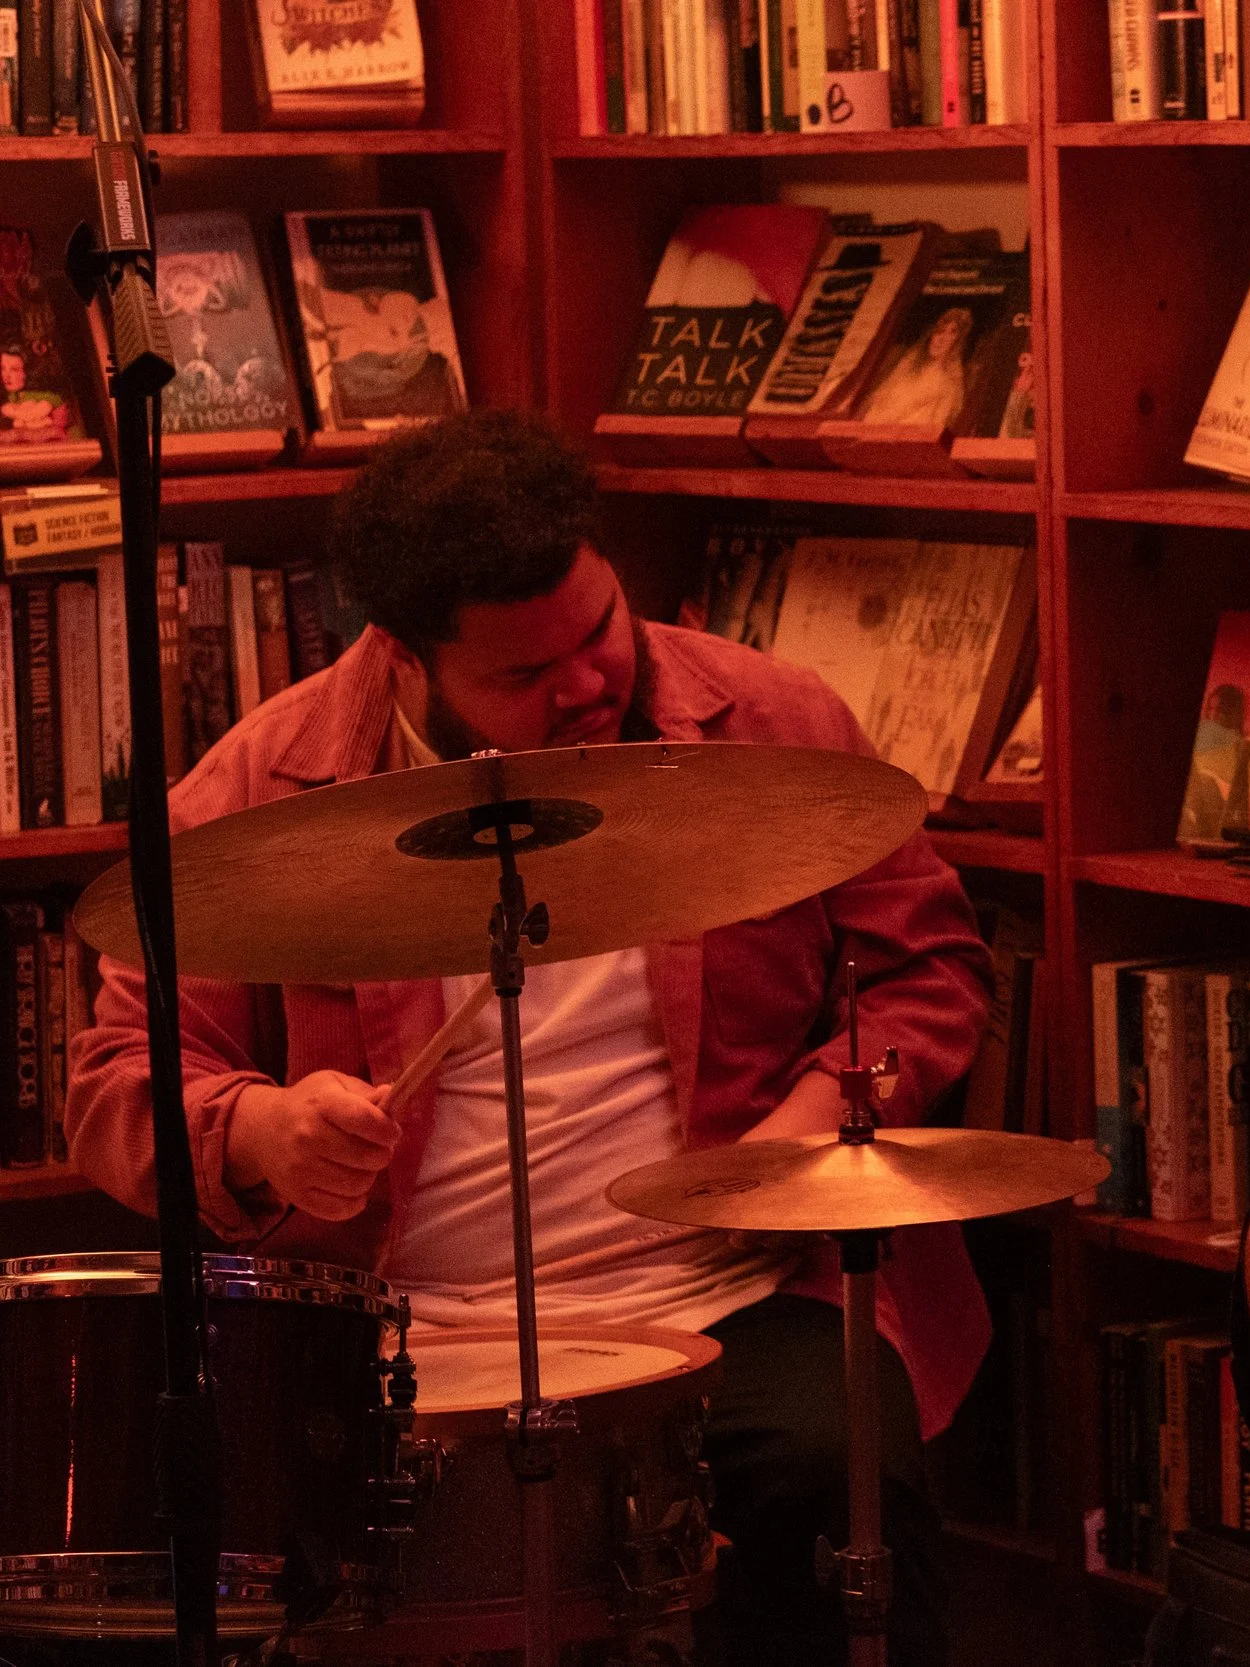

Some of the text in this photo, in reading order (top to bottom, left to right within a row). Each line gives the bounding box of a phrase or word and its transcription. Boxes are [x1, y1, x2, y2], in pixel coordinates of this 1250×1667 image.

[825, 82, 854, 124] B
[113, 179, 137, 240] FRAMEWORKS
[650, 316, 772, 349] TALK
[637, 352, 760, 386] TALK
[666, 389, 747, 408] BOYLE
[44, 509, 109, 530] SCIENCE FICTION
[46, 529, 81, 544] FANTASY
